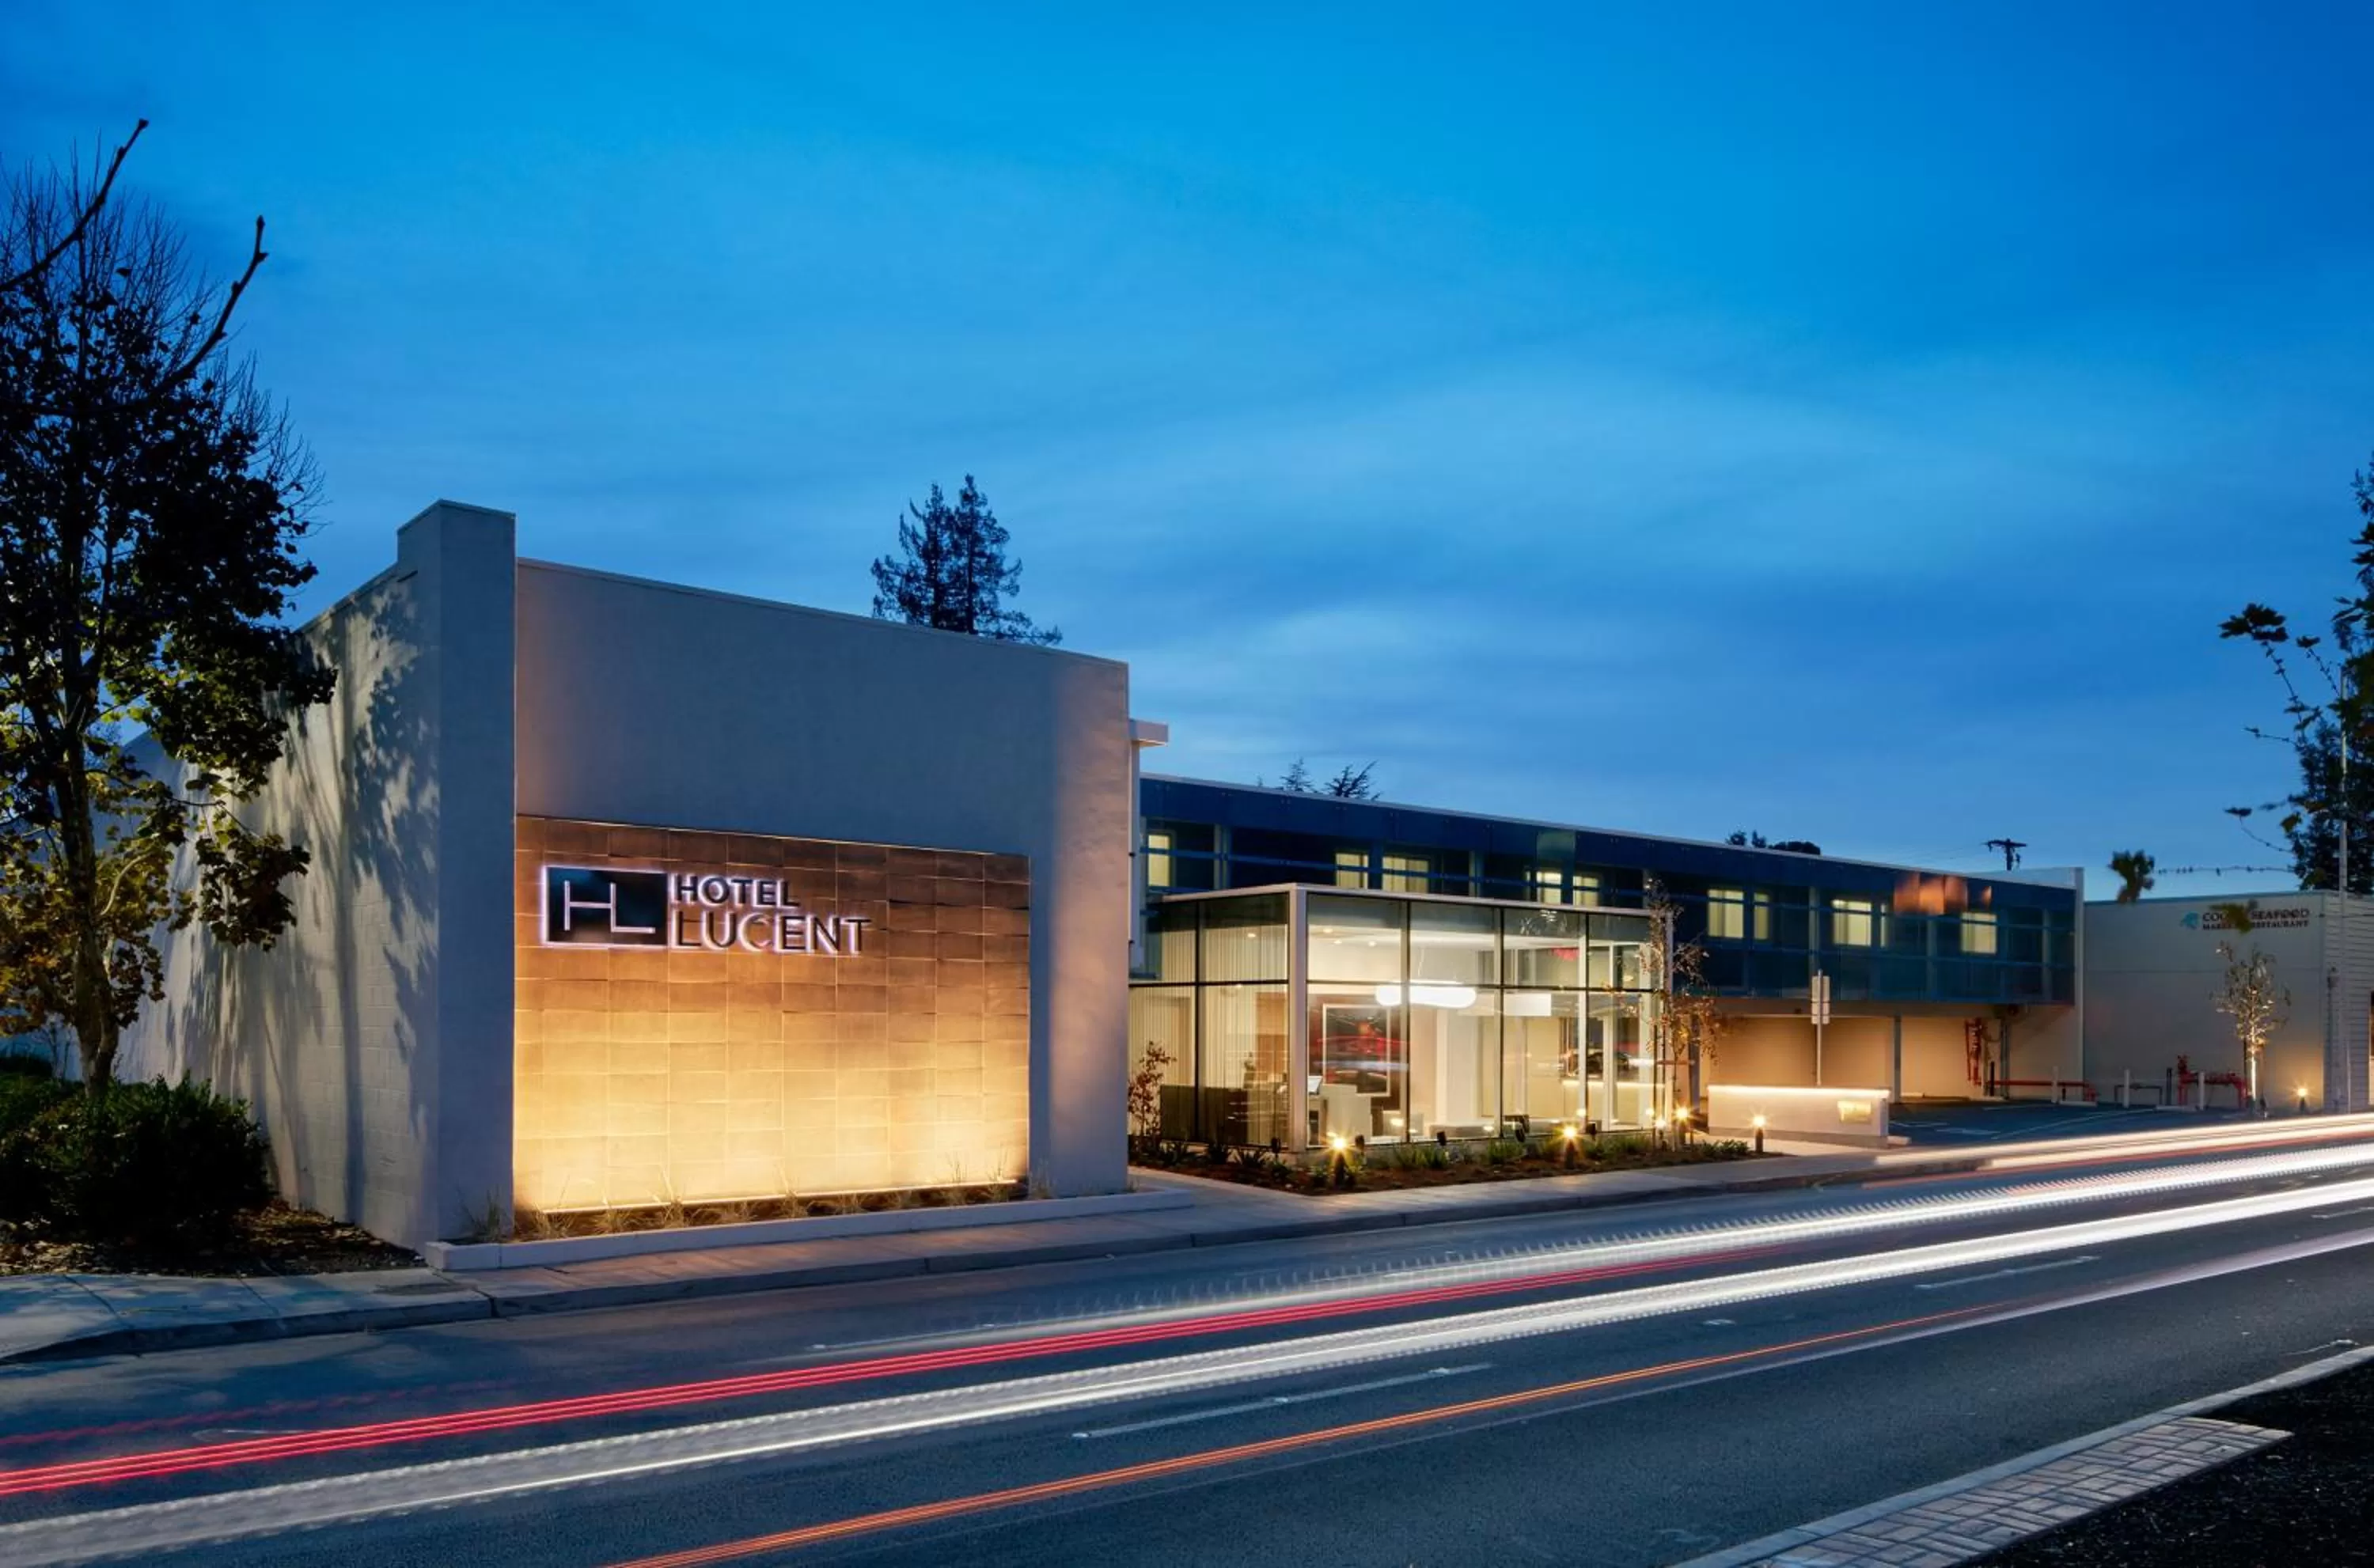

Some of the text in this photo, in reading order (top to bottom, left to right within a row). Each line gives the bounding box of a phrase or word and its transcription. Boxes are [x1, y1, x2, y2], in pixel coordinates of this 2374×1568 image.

[671, 873, 800, 908] HOTEL
[671, 910, 871, 954] LUCENT
[2253, 920, 2309, 929] ESTAURANT
